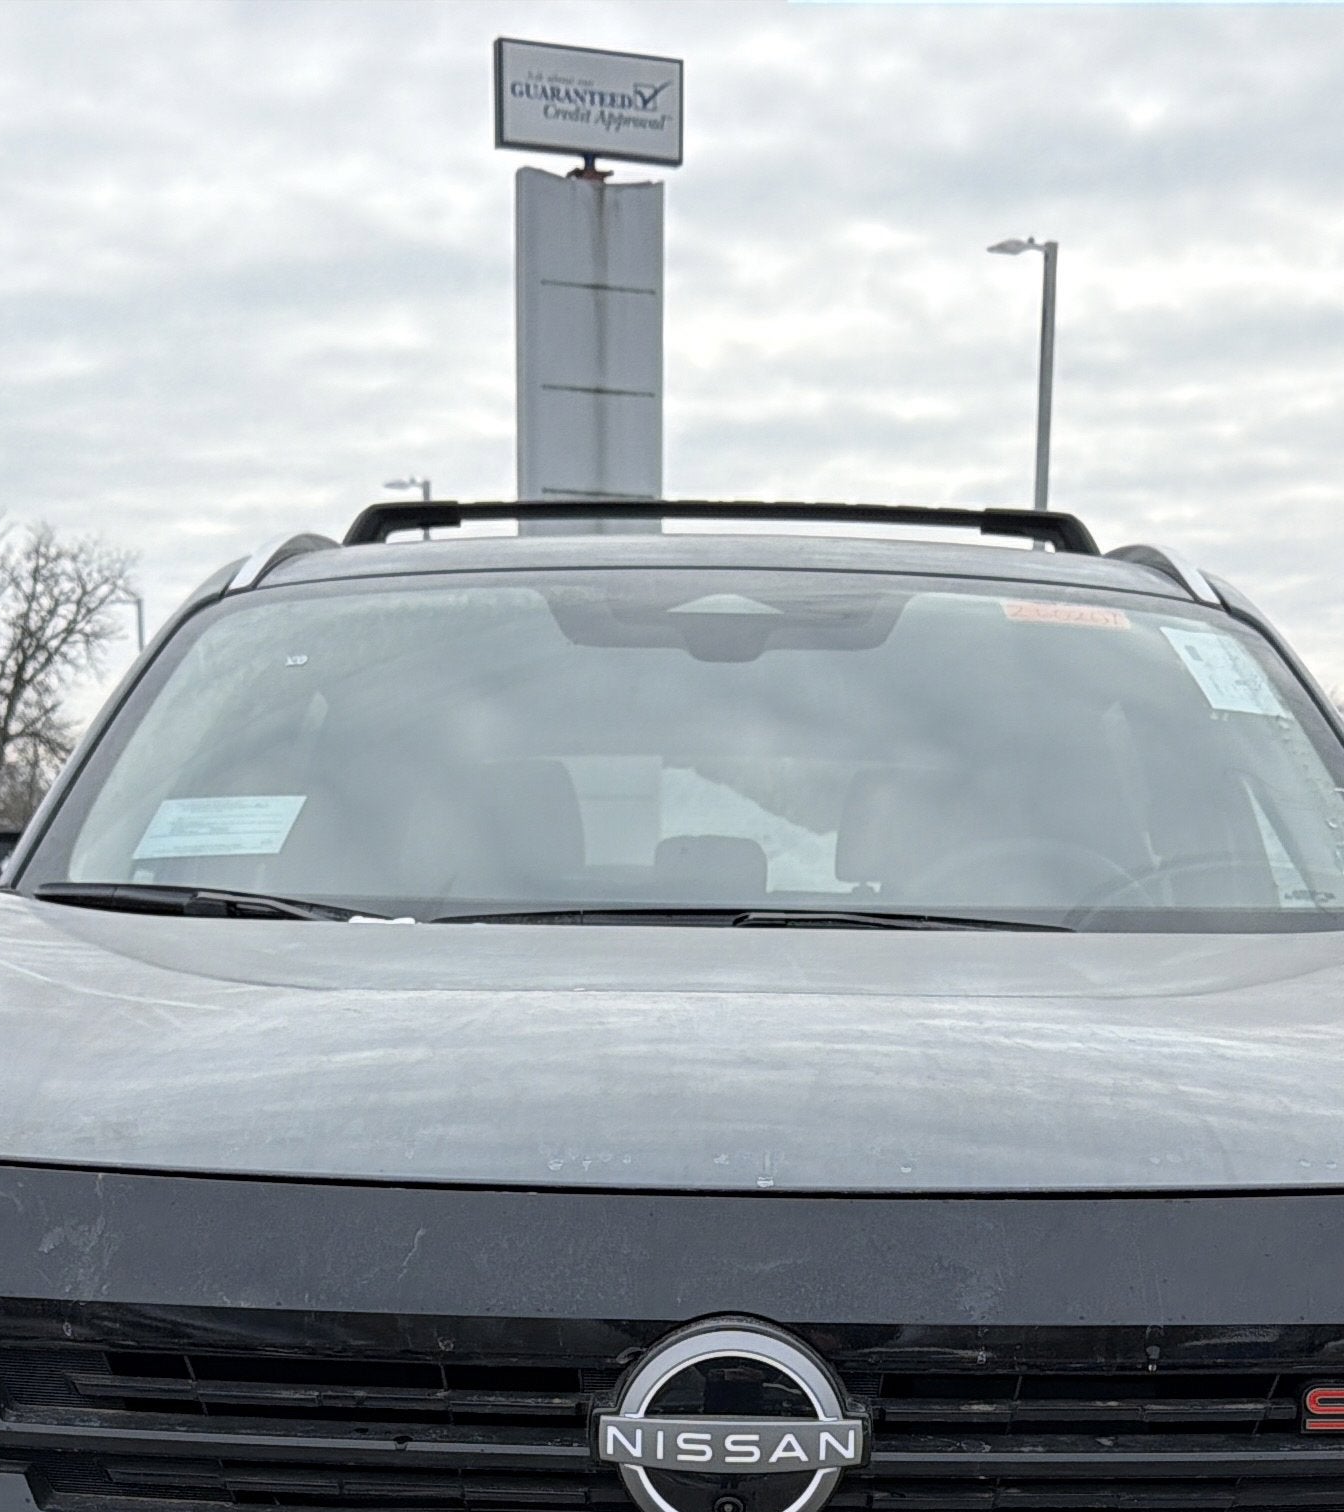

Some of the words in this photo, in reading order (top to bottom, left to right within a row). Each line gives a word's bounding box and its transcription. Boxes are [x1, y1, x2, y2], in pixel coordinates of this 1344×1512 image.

[510, 80, 633, 109] GUARANTEED
[543, 103, 591, 124] Credit
[606, 1425, 855, 1463] NISSAN
